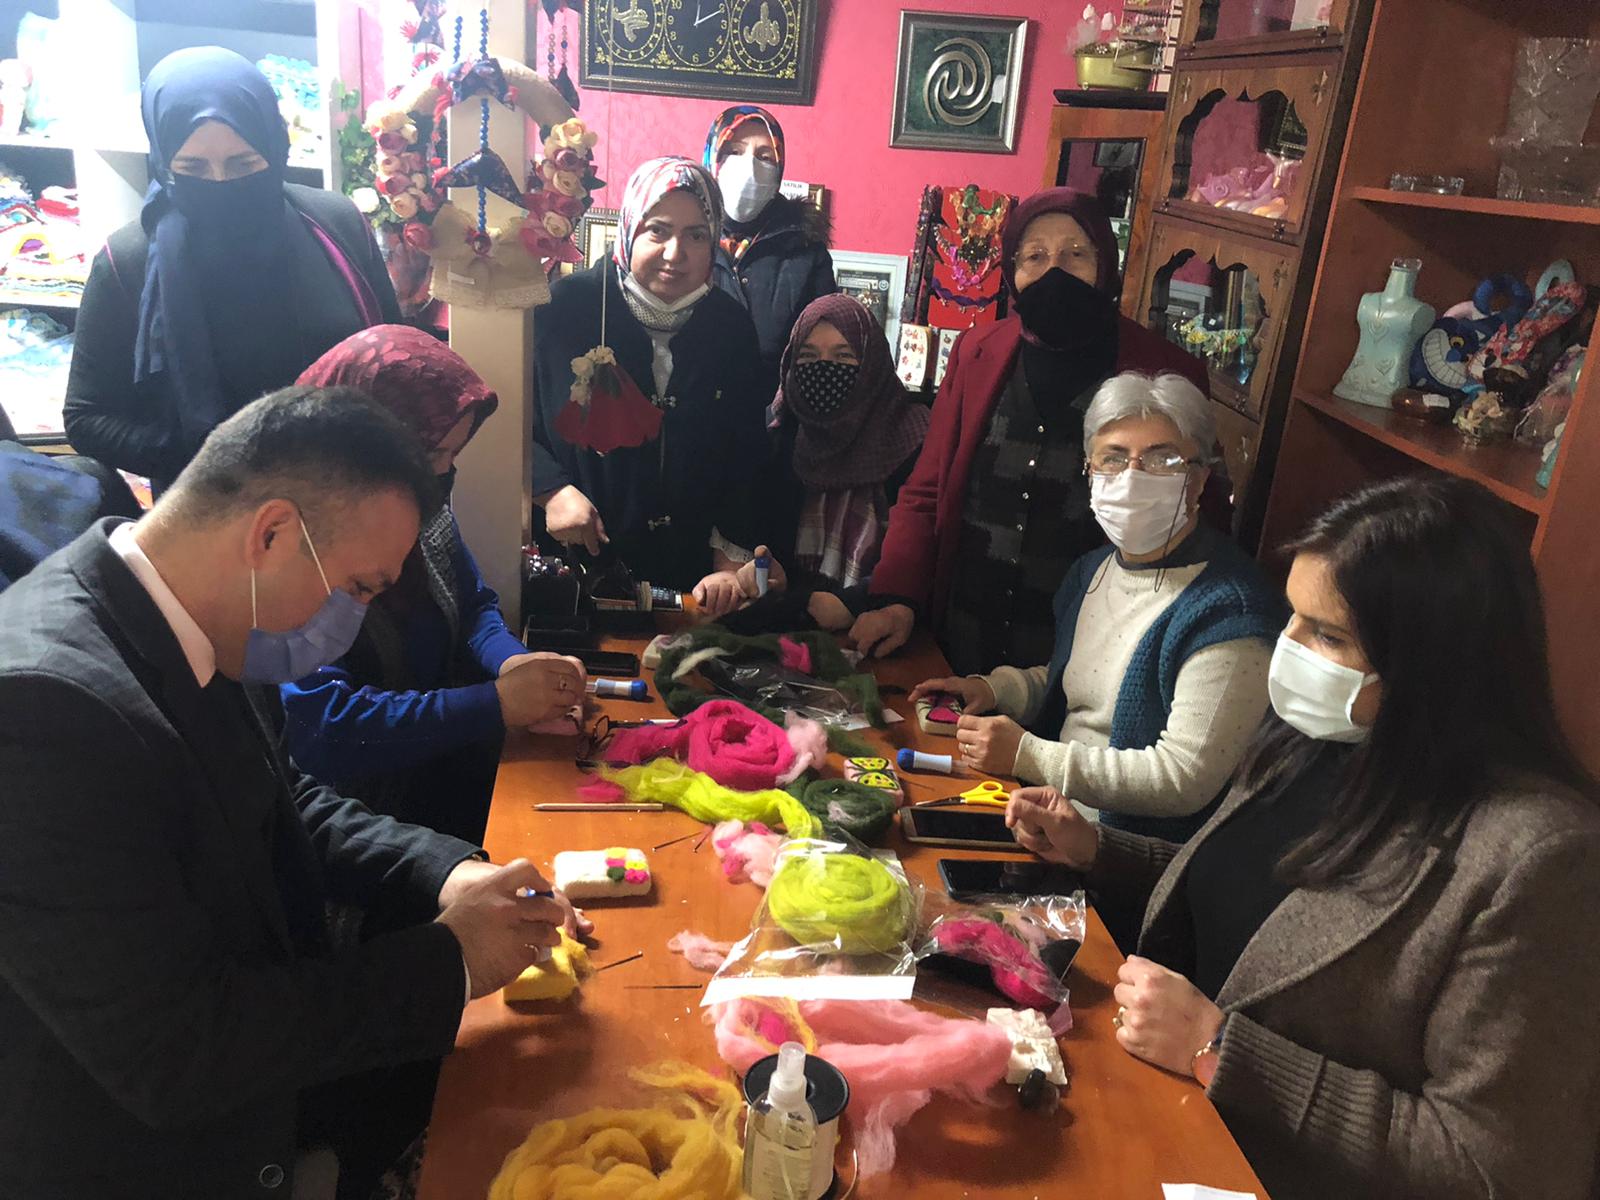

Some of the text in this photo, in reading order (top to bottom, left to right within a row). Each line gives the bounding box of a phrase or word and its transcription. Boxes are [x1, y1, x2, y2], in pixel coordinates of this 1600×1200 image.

[671, 0, 682, 9] 10
[718, 3, 725, 13] 2
[667, 15, 674, 25] 9
[721, 19, 727, 30] 3
[670, 31, 677, 41] 8
[716, 35, 723, 45] 4
[676, 45, 684, 55] 7
[708, 47, 715, 57] 5
[692, 53, 699, 63] 6
